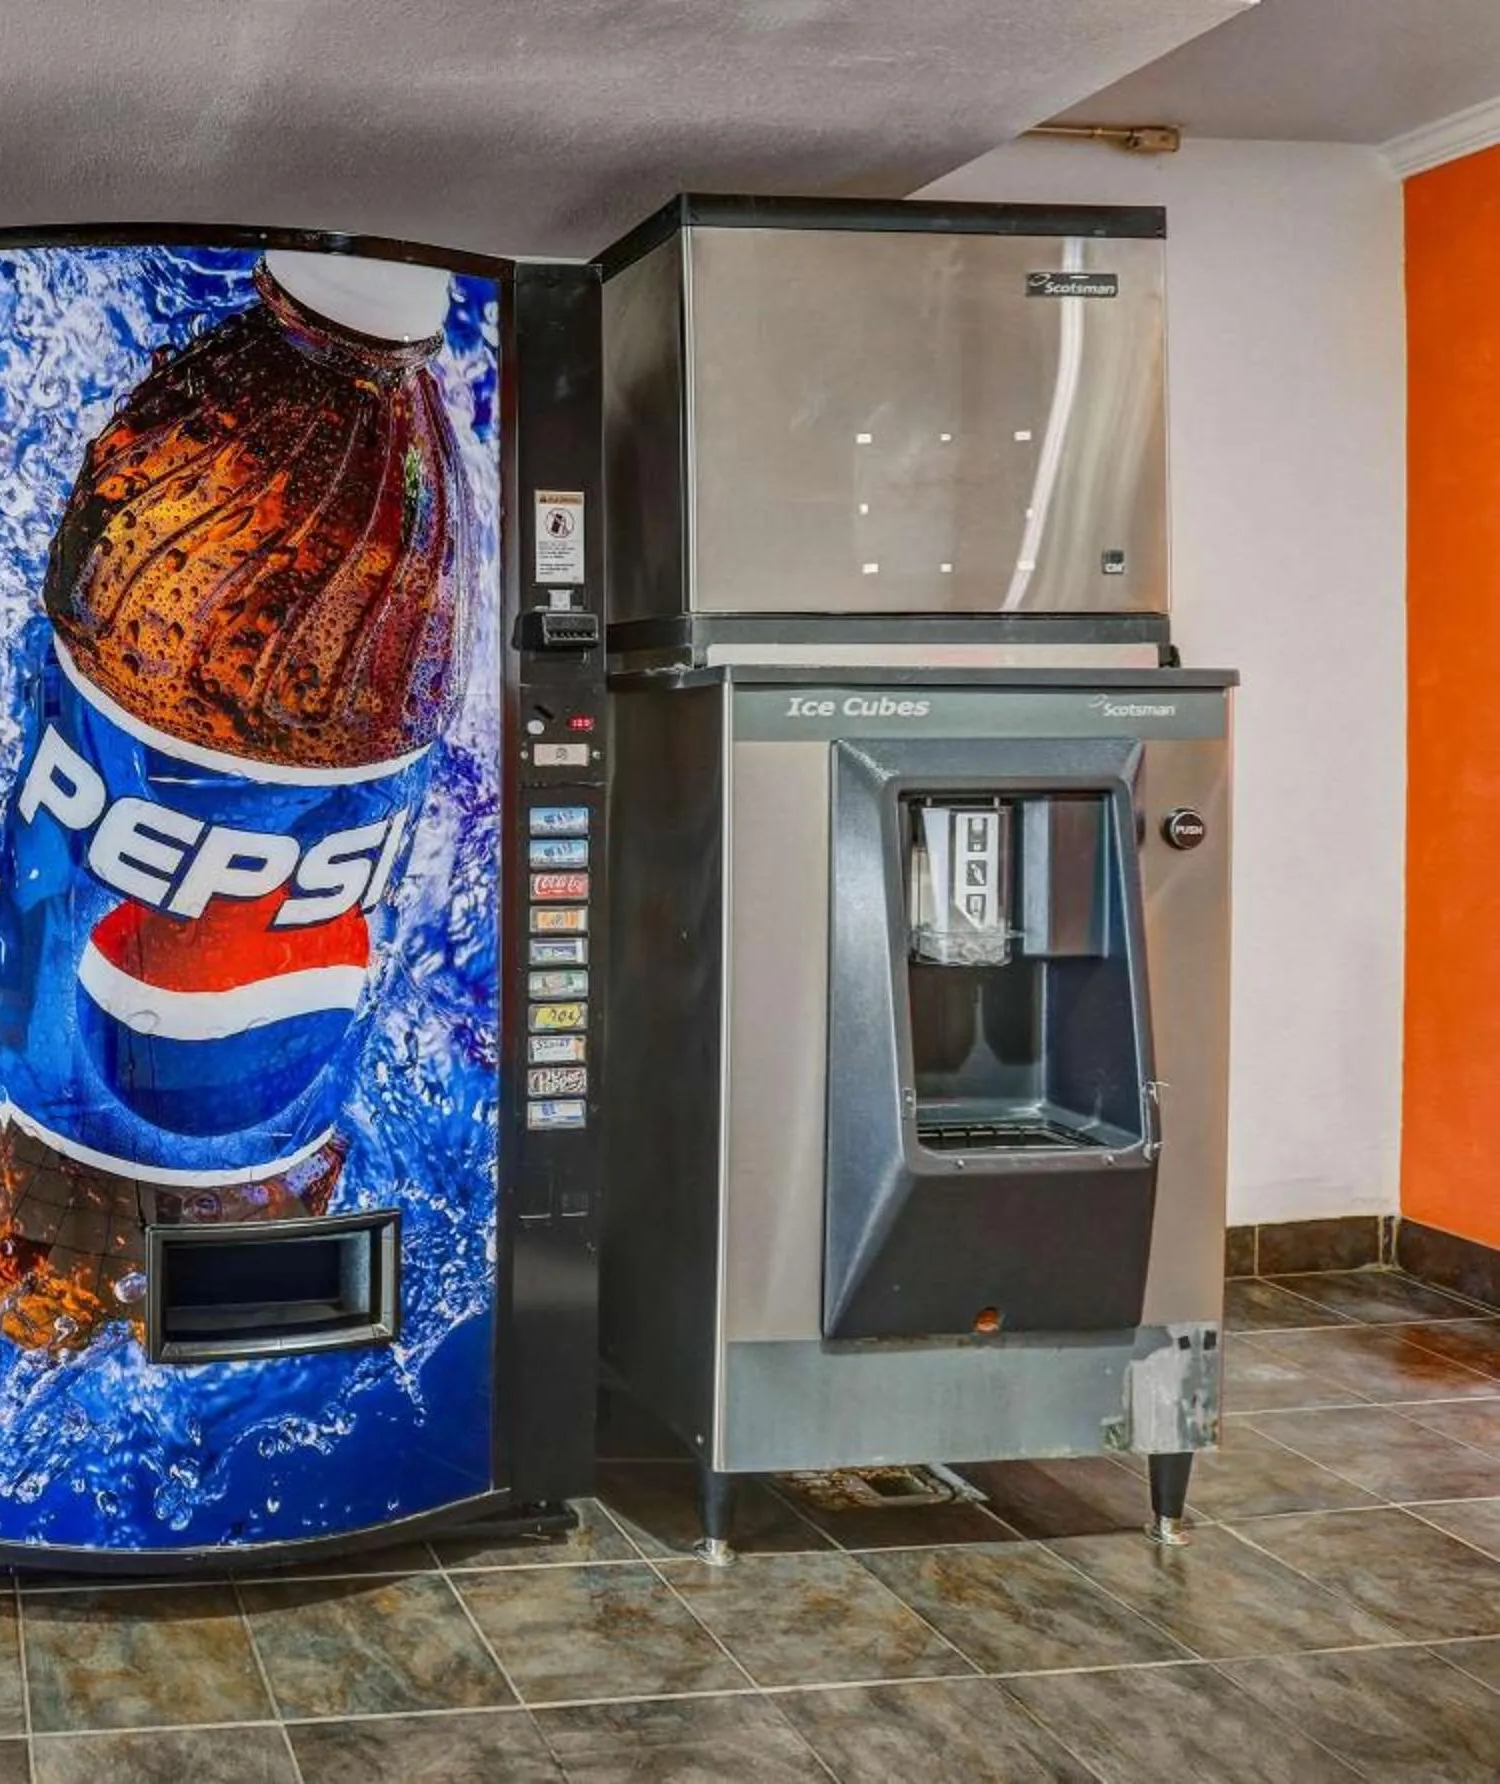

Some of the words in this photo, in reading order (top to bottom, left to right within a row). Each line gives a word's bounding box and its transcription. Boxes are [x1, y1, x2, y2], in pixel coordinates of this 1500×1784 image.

[1044, 281, 1116, 295] Scotsman
[785, 697, 836, 717] Ice
[843, 696, 931, 717] Cubes
[1103, 703, 1176, 717] Scotsman
[17, 723, 411, 929] PEPSI
[1175, 825, 1203, 835] PUSH
